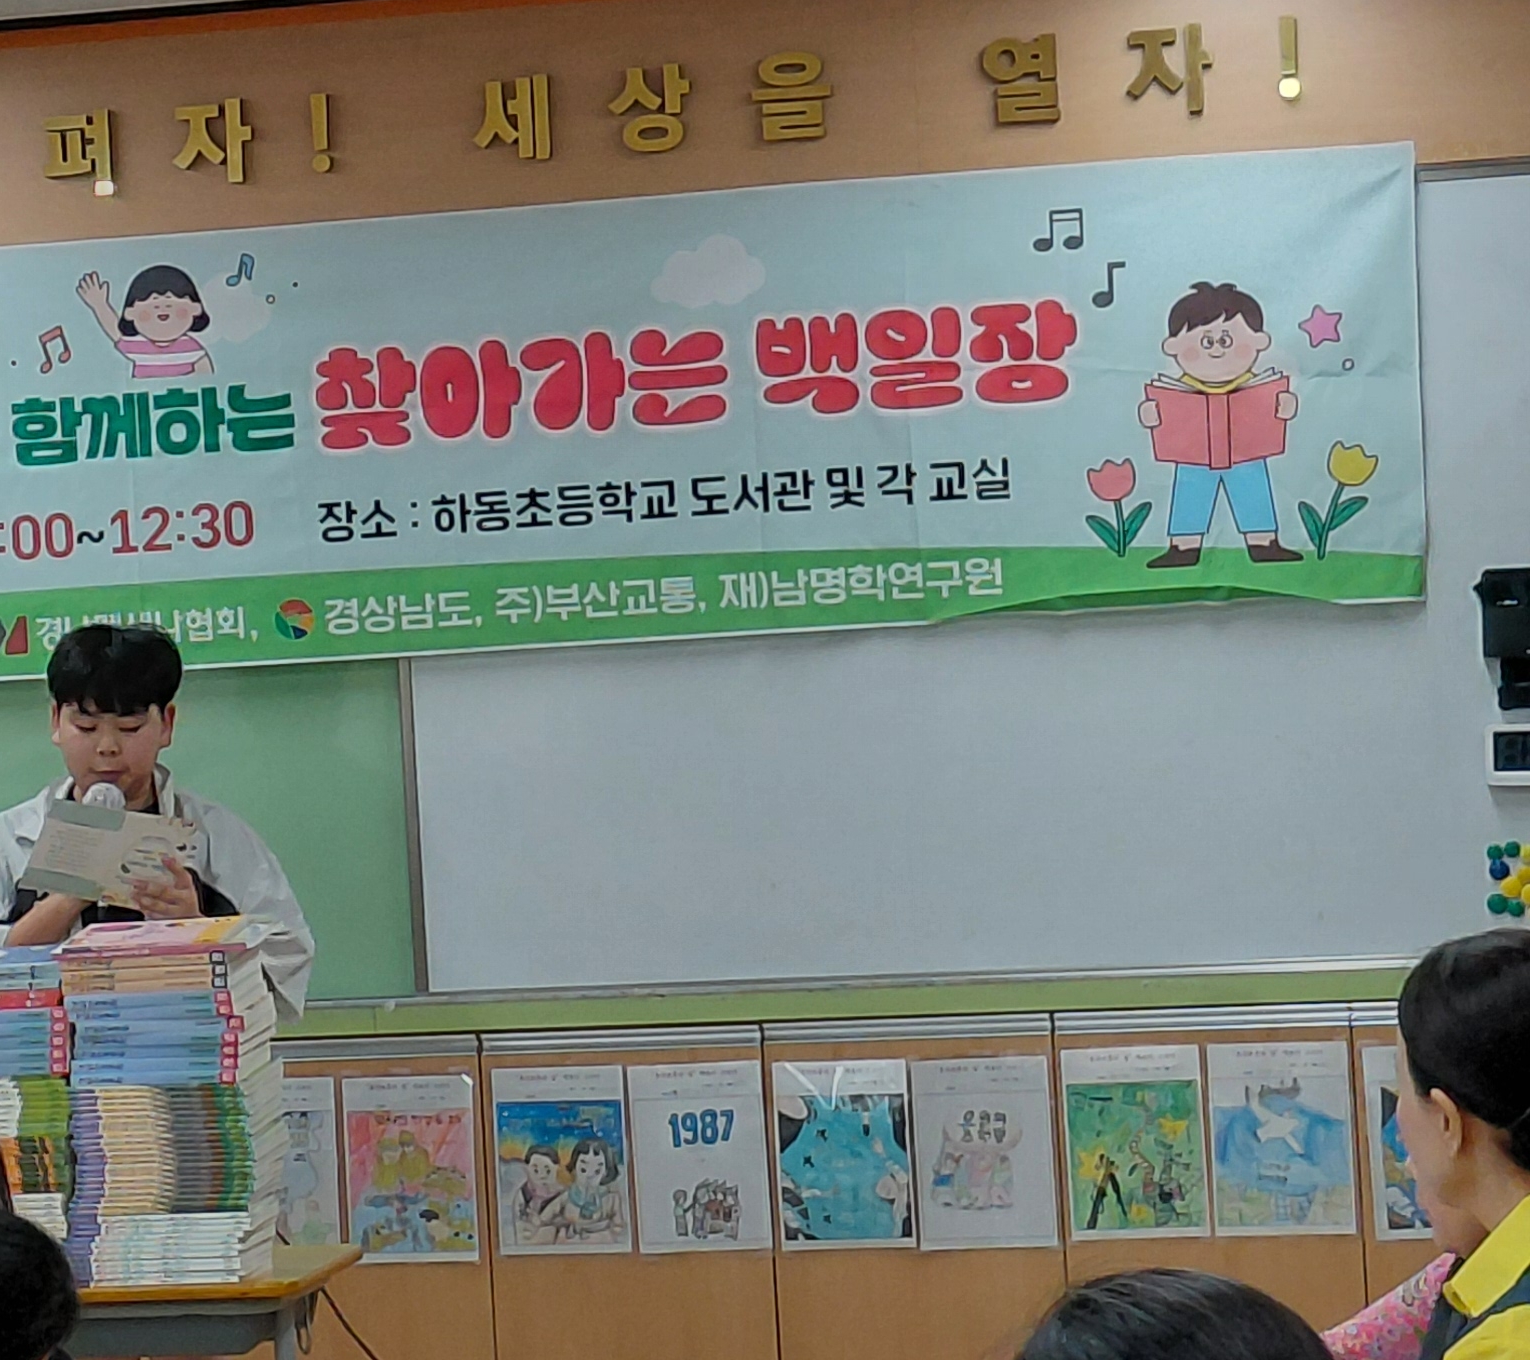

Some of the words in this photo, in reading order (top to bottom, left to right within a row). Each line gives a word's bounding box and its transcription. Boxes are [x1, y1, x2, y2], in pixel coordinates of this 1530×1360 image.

[43, 92, 337, 198] 펴자!
[474, 50, 833, 160] 세상을
[981, 15, 1304, 125] 열자!
[315, 328, 729, 450] 찾아가는
[755, 299, 1078, 414] 백일장
[11, 383, 296, 466] 함께하는
[430, 479, 679, 533] 하동초등학교
[690, 468, 815, 517] 도서관
[826, 466, 866, 510] 및
[876, 462, 917, 505] 각
[929, 456, 1011, 502] 교실
[323, 590, 483, 635] 경상남도,
[495, 576, 707, 625] 주)부산교통,
[718, 557, 1005, 611] 재)남명학연구원
[668, 1108, 735, 1148] 1987
